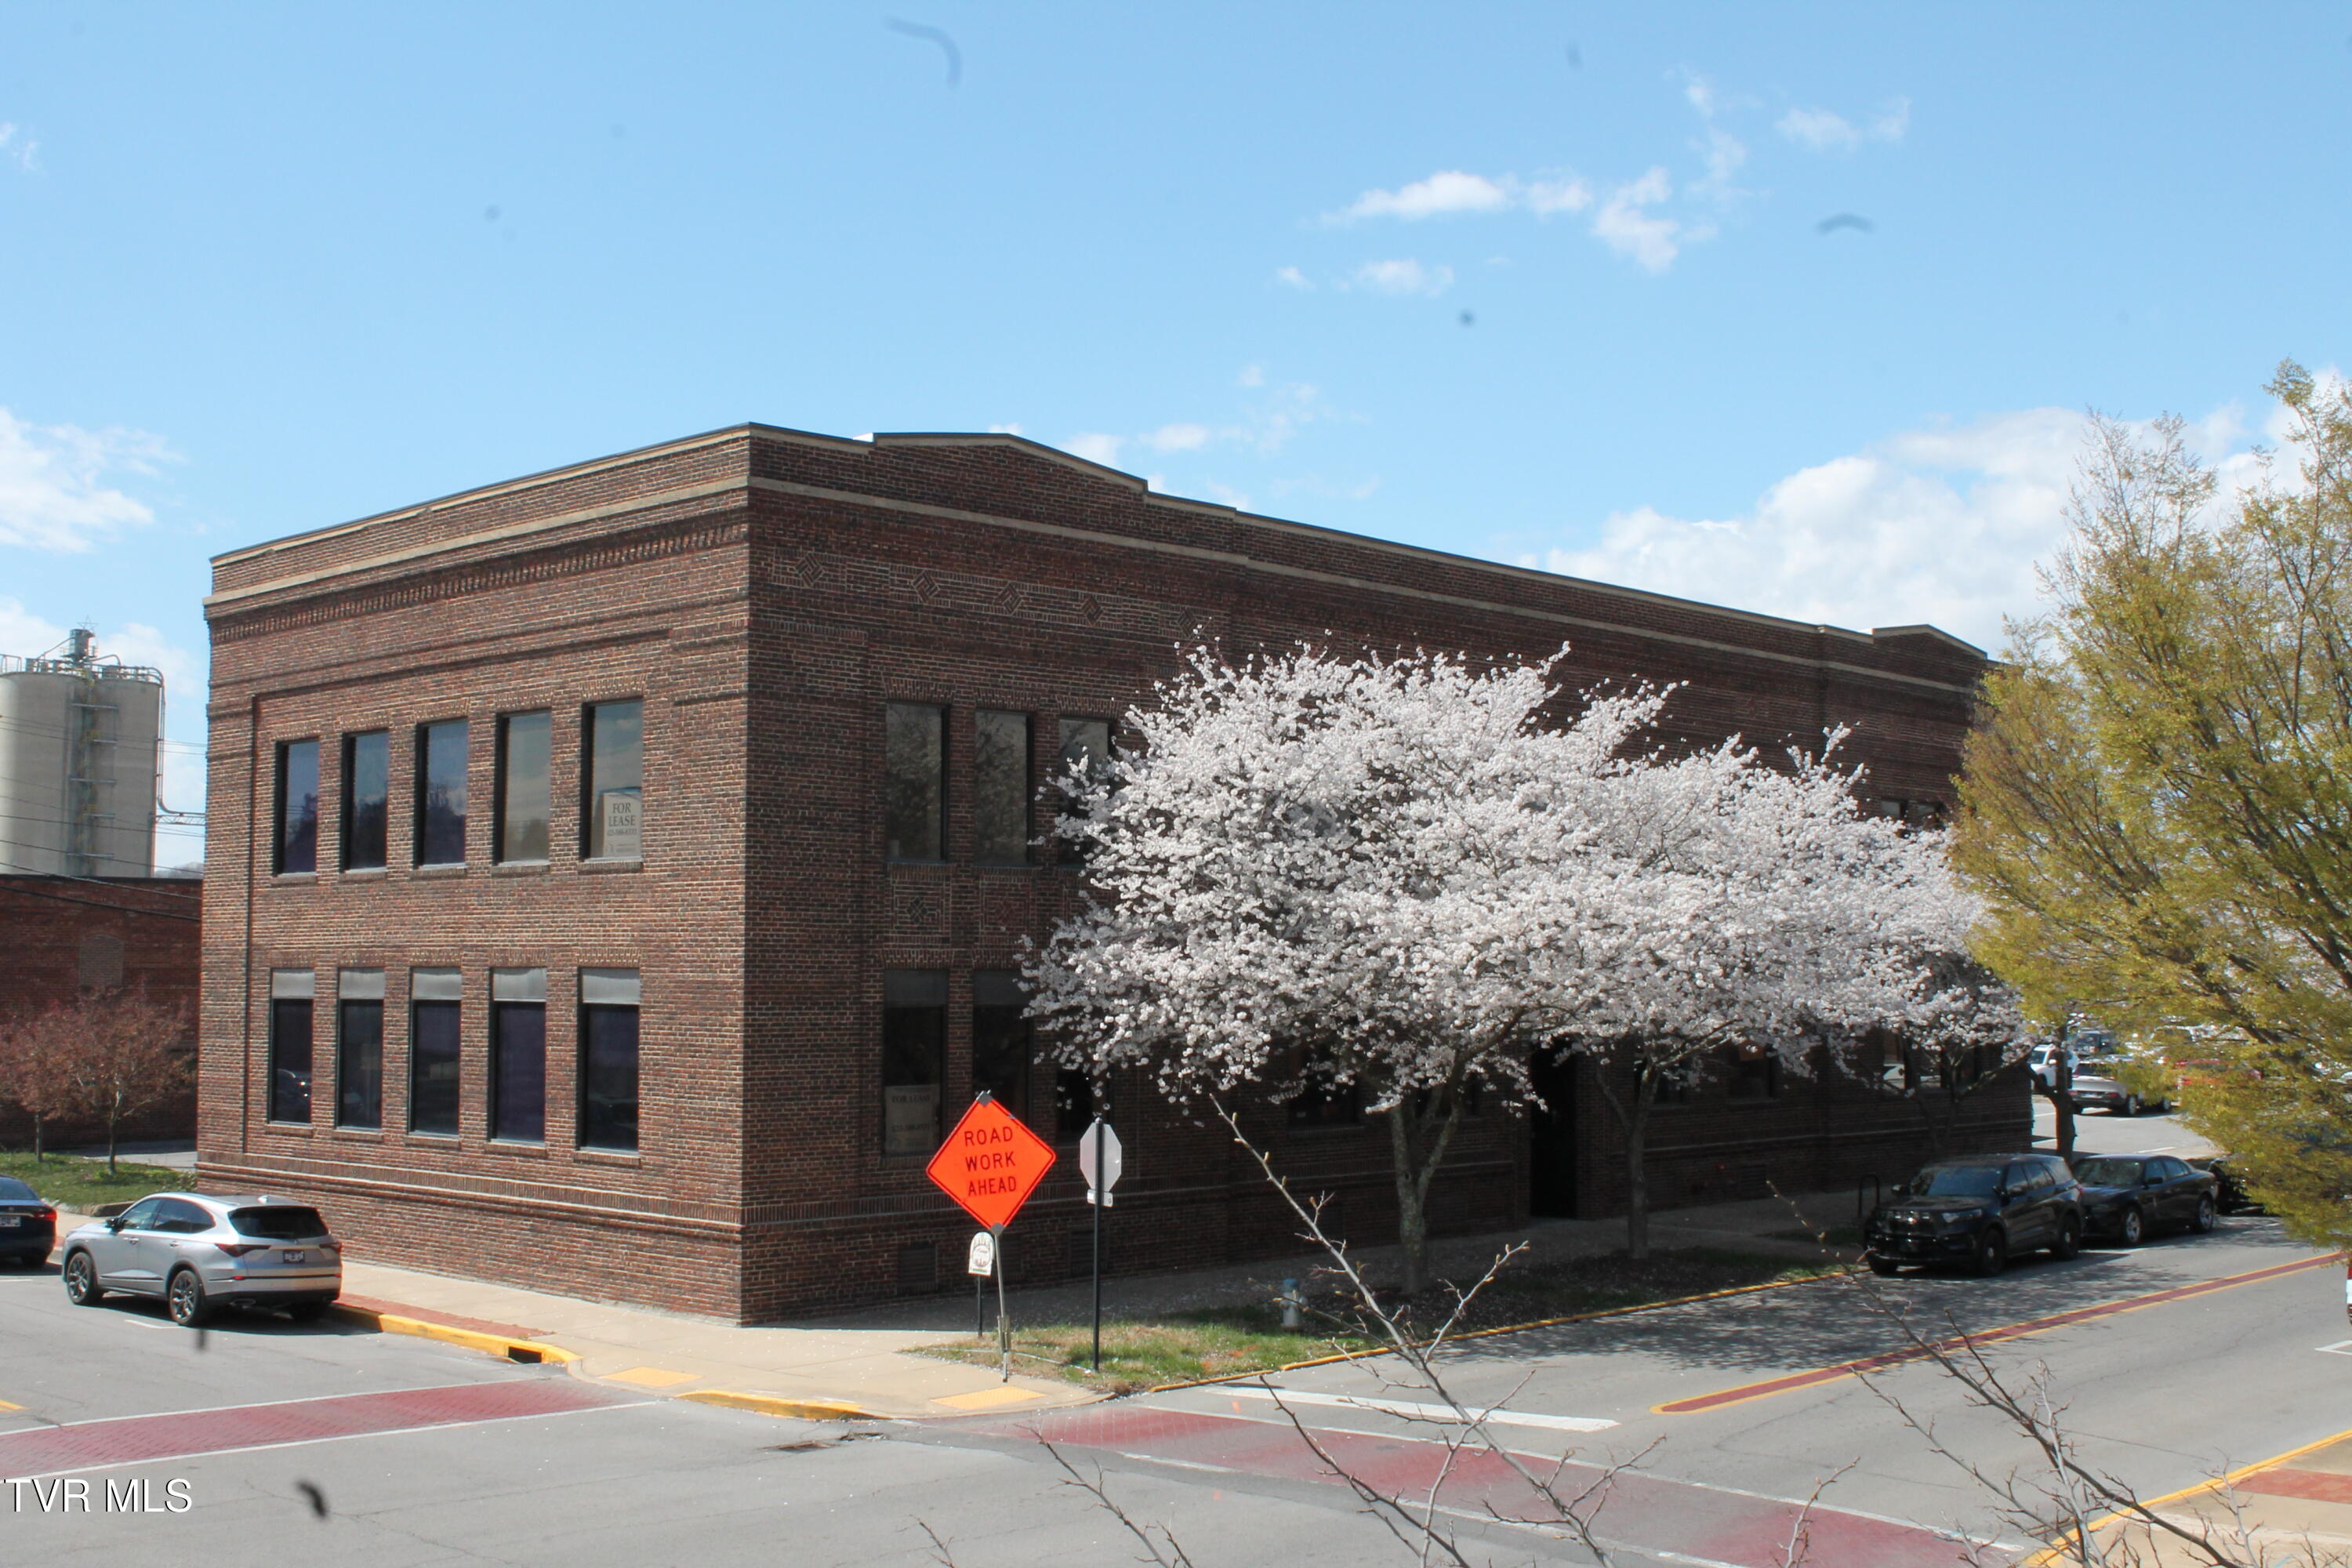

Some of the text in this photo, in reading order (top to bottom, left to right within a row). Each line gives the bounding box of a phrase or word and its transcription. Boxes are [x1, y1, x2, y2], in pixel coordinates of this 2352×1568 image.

[612, 803, 631, 814] FOR
[608, 815, 637, 827] LEASE
[964, 1126, 1013, 1147] ROAD
[965, 1151, 1016, 1172] WORK
[968, 1176, 1017, 1197] AHEAD
